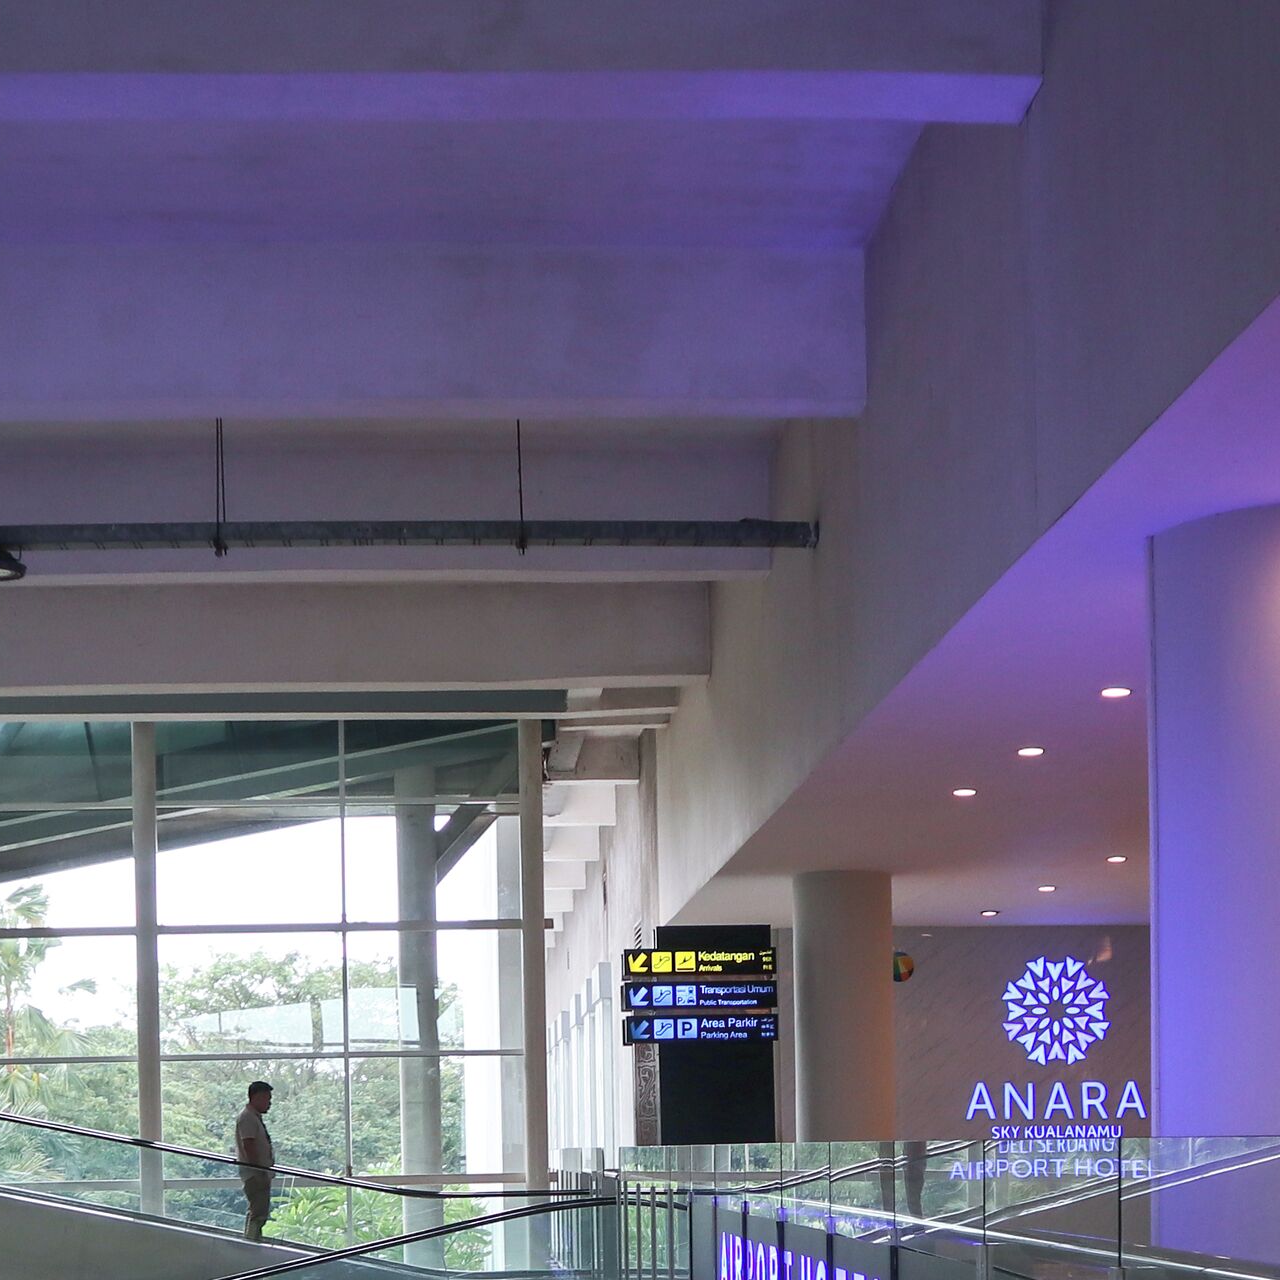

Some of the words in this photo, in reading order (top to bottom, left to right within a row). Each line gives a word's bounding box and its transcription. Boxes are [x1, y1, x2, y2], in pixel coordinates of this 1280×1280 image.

[698, 951, 755, 963] Kedatangan
[700, 985, 746, 996] Transportasi
[747, 985, 773, 994] Umum
[701, 1018, 725, 1028] Area
[728, 1017, 758, 1028] Parkir
[701, 1031, 728, 1039] Parking
[965, 1080, 1148, 1121] ANARA
[991, 1126, 1021, 1140] SKY
[1024, 1125, 1123, 1139] KUALANAMU
[949, 1159, 1067, 1181] AIRPORT
